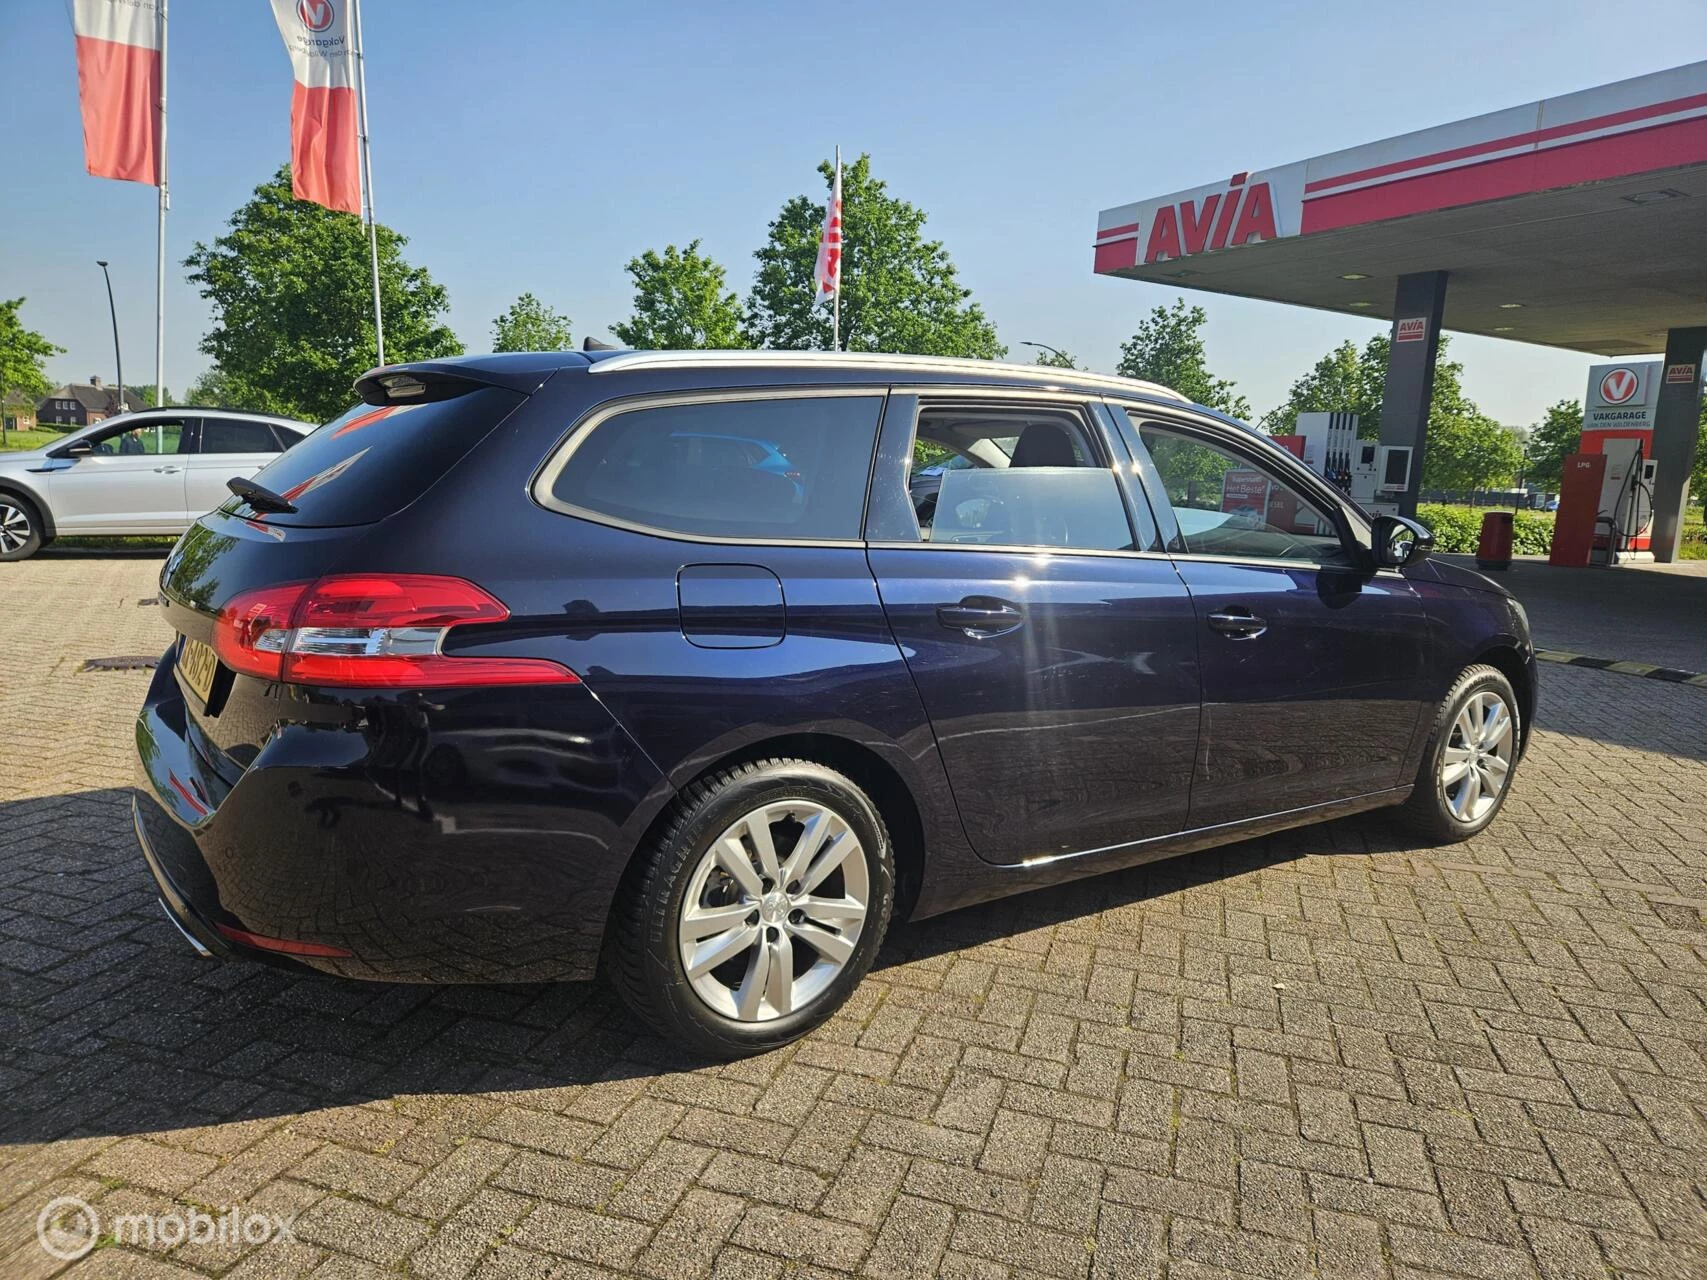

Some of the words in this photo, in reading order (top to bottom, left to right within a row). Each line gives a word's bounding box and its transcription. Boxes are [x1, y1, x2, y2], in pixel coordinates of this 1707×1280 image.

[1145, 171, 1276, 263] AVIA
[1400, 319, 1424, 331] AVIA
[1669, 365, 1693, 376] AVIA
[1593, 411, 1647, 421] VAKGARAGE
[1577, 461, 1592, 469] LPG
